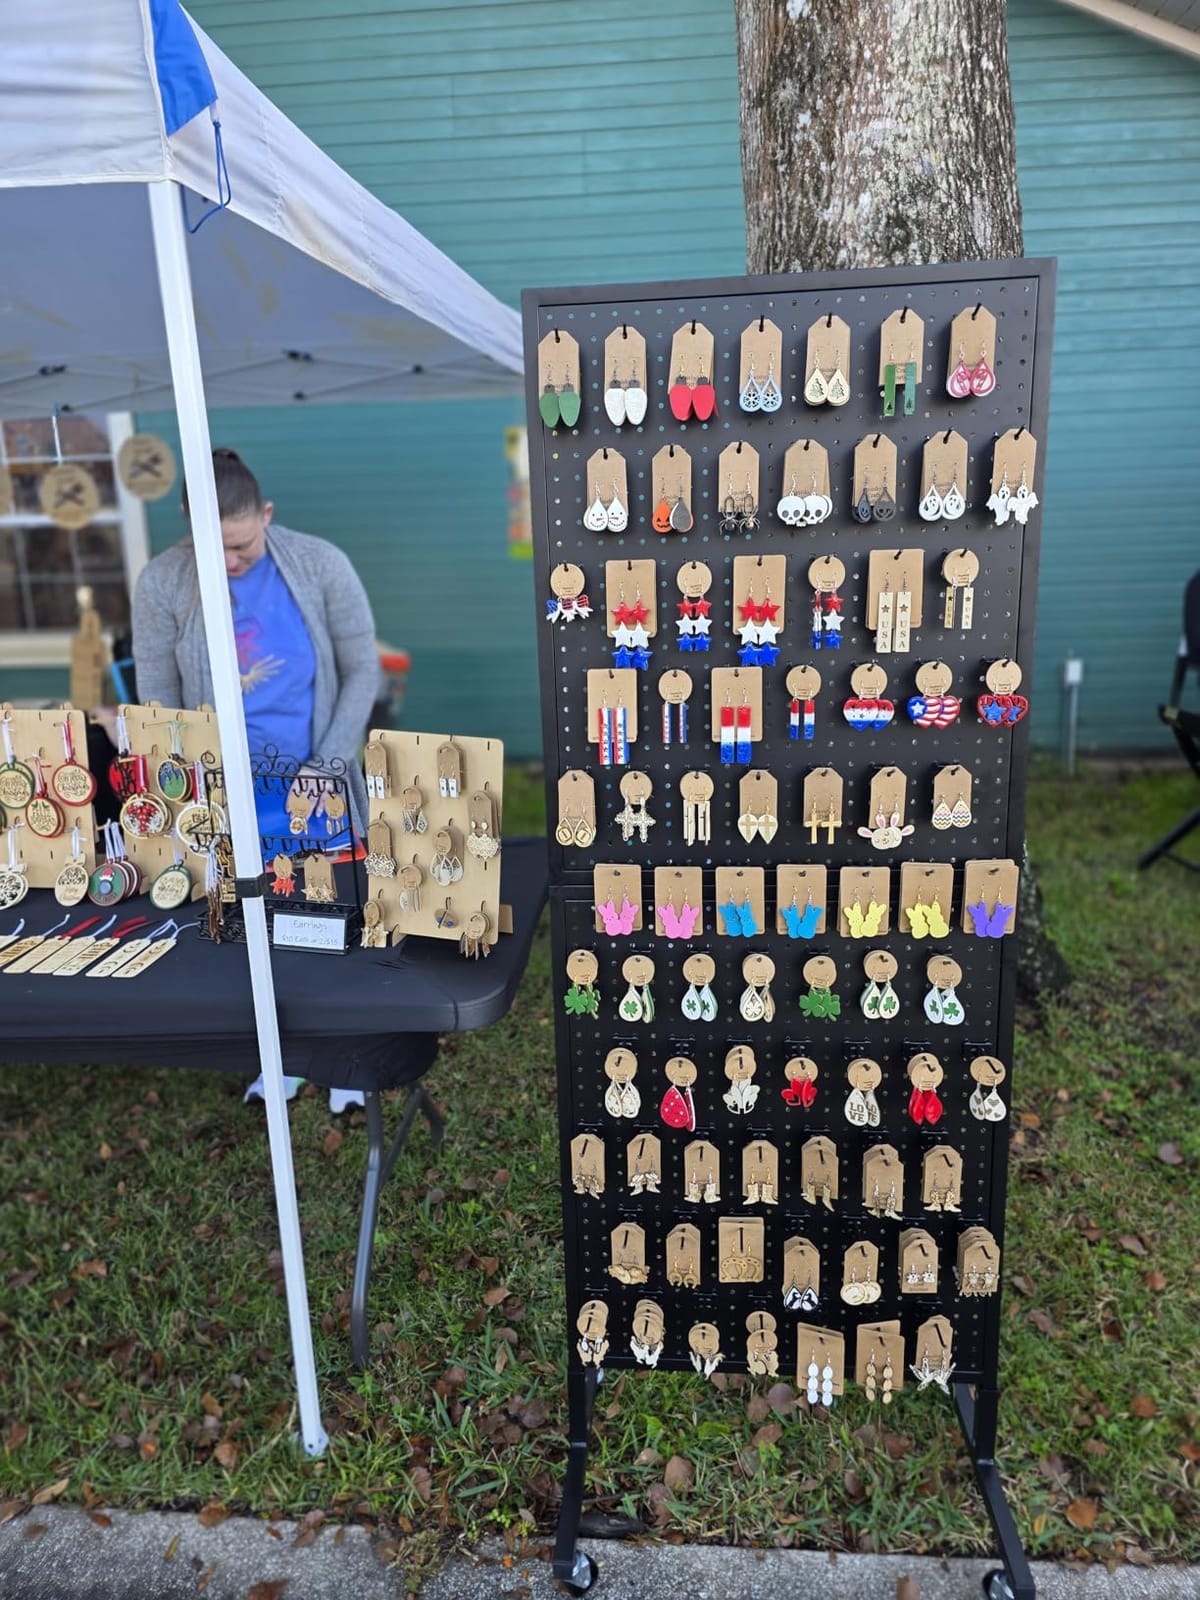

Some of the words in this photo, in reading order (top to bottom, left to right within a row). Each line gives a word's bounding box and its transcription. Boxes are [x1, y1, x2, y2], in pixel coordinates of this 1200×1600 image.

[880, 620, 889, 649] USA
[898, 620, 907, 649] USA
[293, 919, 328, 933] Earrings
